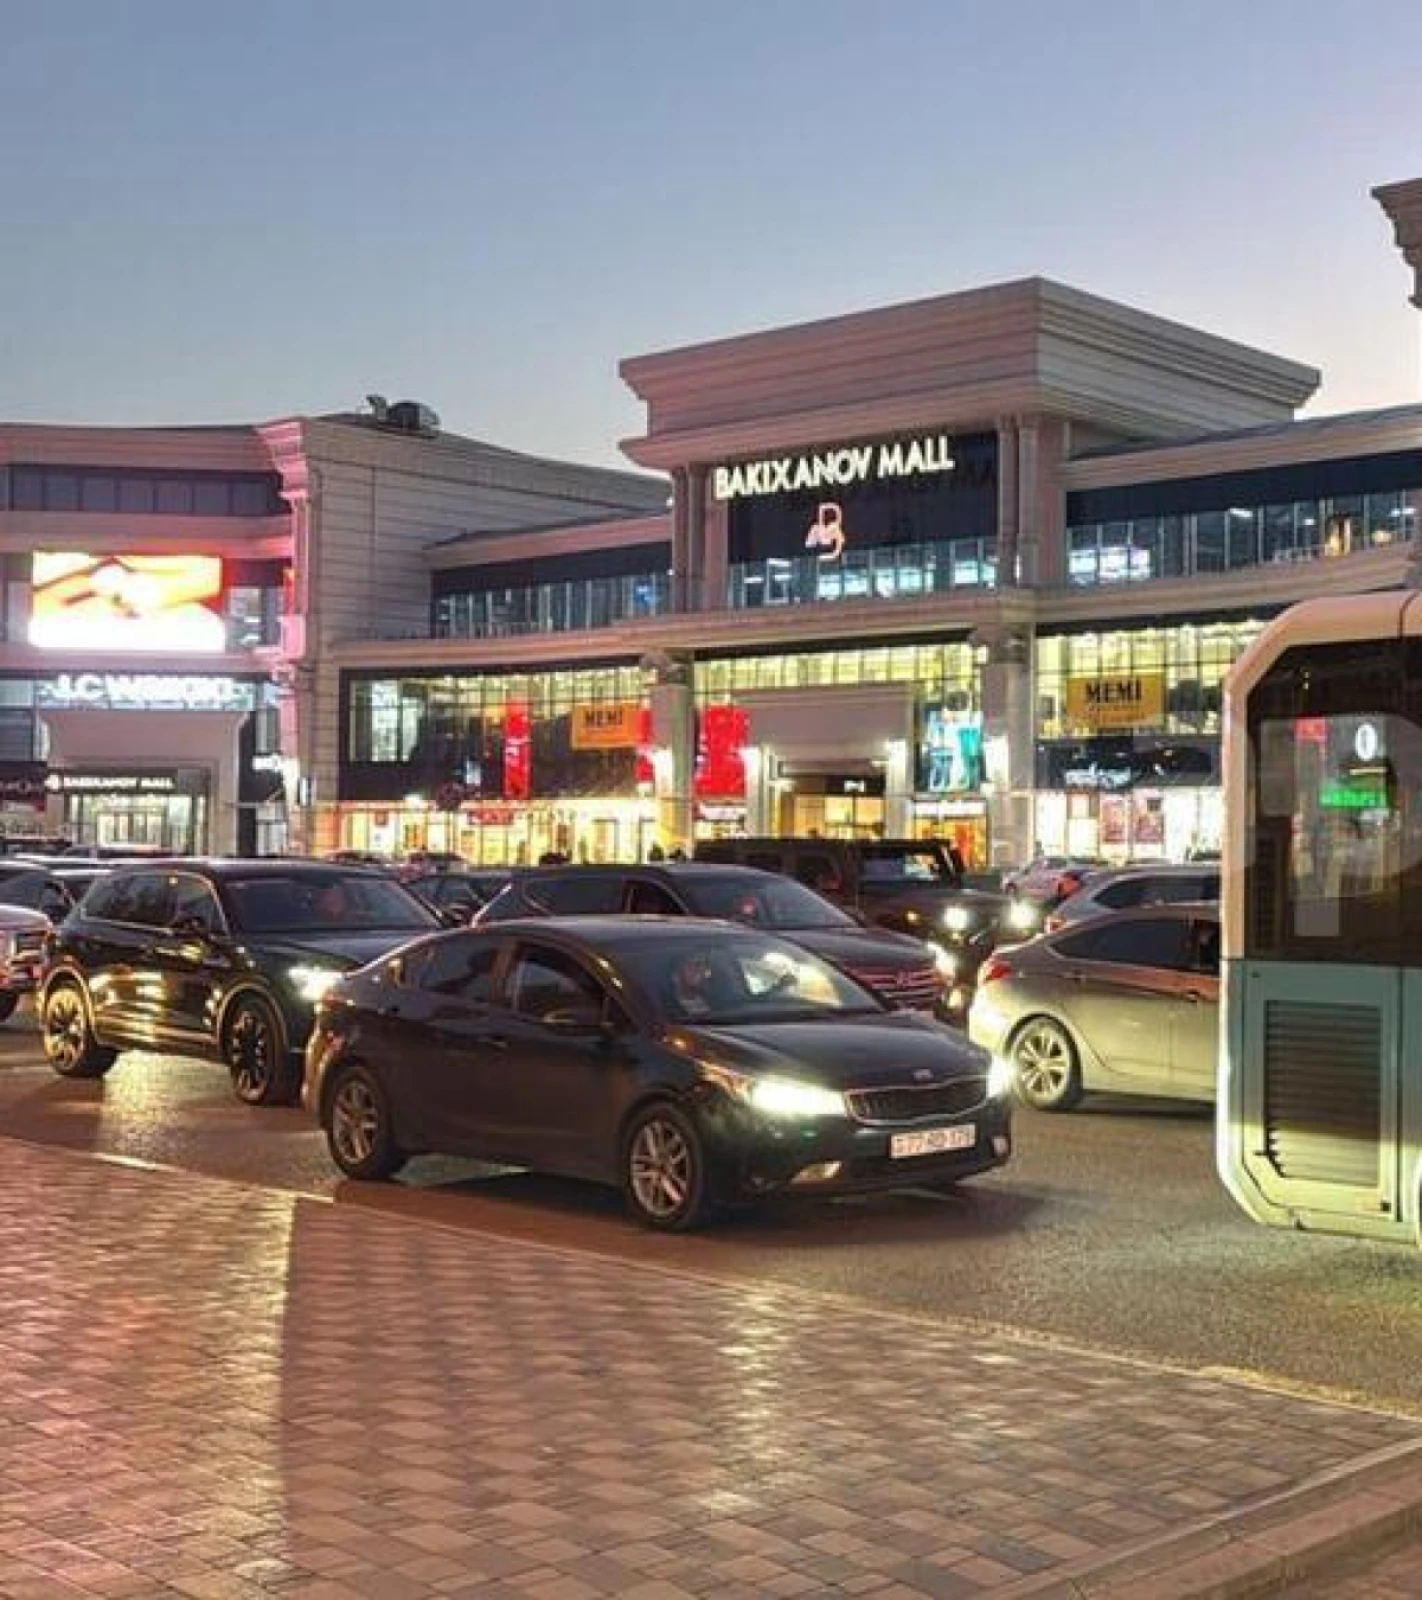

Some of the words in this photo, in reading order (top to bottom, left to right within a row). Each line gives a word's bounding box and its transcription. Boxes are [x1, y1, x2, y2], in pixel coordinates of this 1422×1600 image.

[713, 446, 873, 500] BAKIXANOV
[877, 435, 955, 478] MALL
[1085, 679, 1142, 703] MEMI
[583, 709, 624, 728] MEMI
